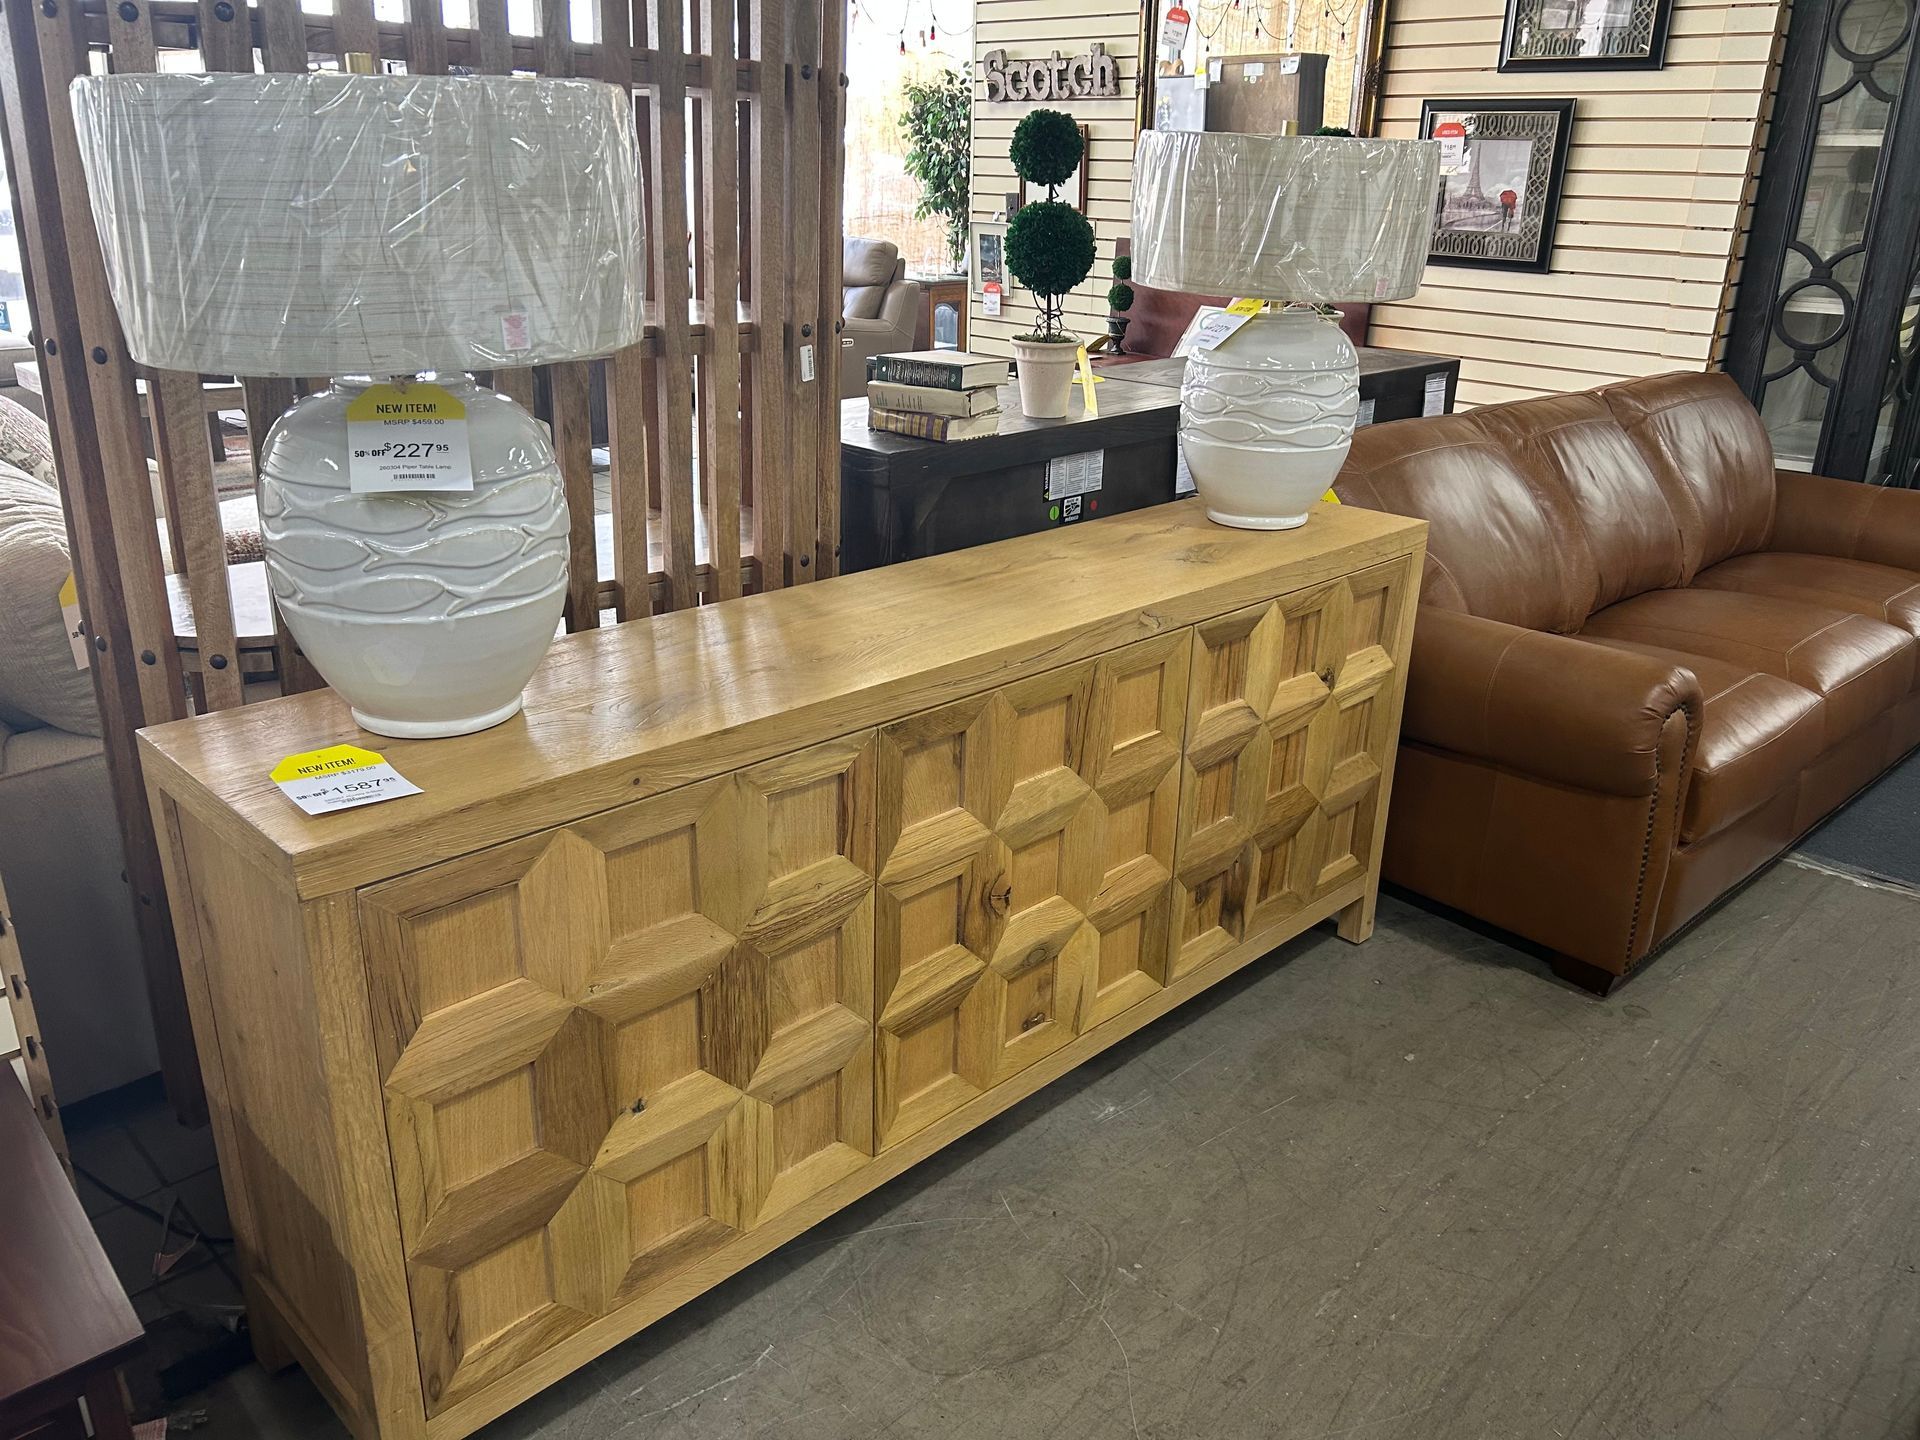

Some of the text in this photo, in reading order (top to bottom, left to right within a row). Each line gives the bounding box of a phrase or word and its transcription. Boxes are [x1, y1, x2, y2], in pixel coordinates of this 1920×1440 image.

[983, 42, 1120, 103] Scotch
[376, 404, 437, 414] NEW ITEM!
[371, 449, 386, 457] OFF
[297, 757, 356, 775] NEW ITEM!
[314, 765, 377, 780] MSRP $3179.00
